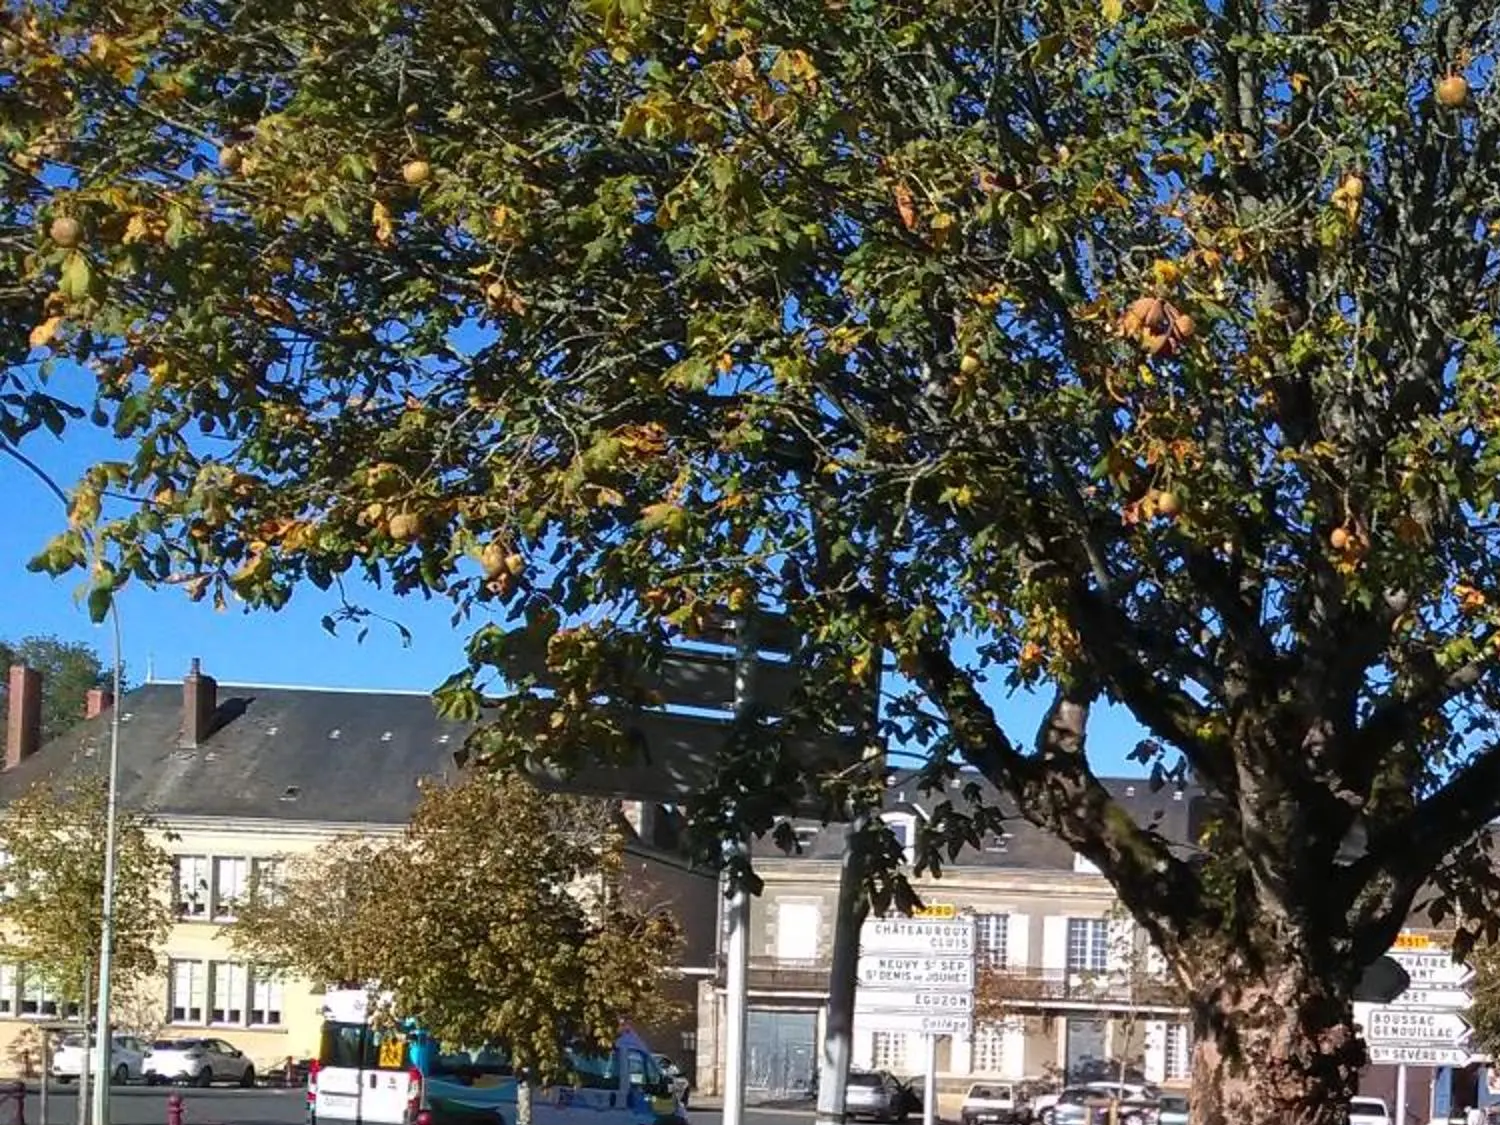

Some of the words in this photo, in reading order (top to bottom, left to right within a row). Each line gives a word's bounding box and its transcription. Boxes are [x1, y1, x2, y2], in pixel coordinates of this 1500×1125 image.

[875, 923, 968, 936] CHÂTEAUROUX
[930, 937, 968, 949] CLUIS
[879, 959, 918, 970] NEUVY
[879, 971, 912, 981] DENIS
[1374, 1014, 1434, 1026] BOUSSAC
[1374, 1025, 1452, 1038] GENOUILLAC
